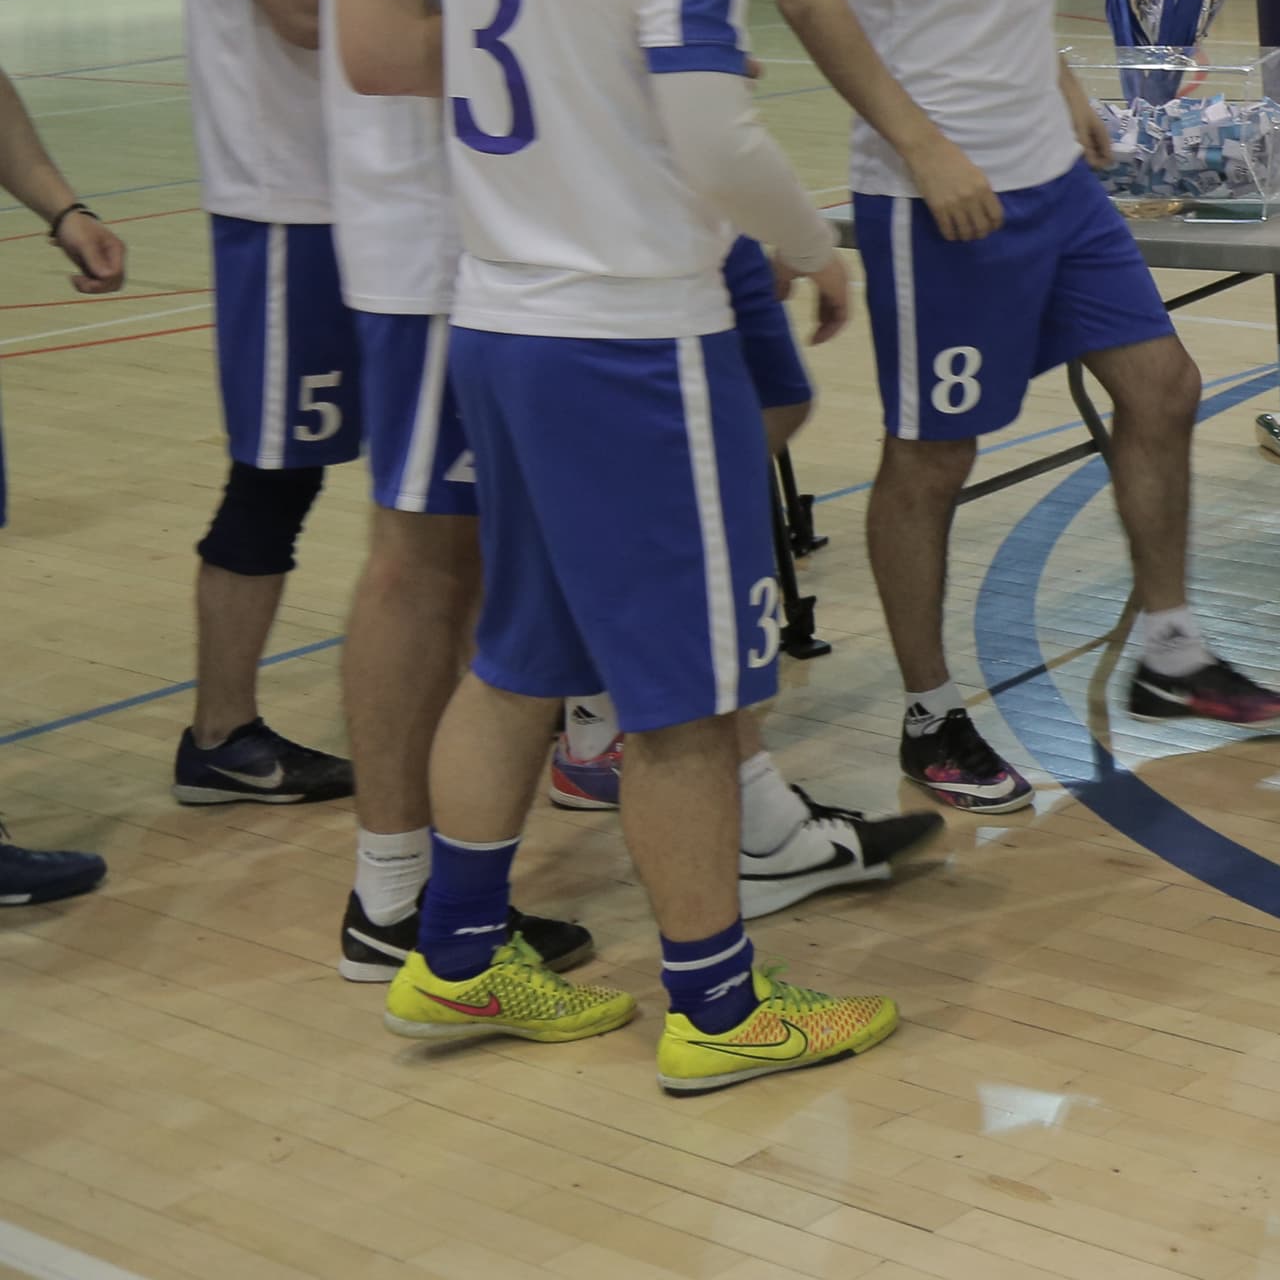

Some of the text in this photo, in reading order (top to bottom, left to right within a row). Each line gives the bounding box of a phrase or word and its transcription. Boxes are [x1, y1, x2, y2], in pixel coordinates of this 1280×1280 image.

[293, 371, 343, 441] 5
[931, 346, 983, 414] 8
[747, 577, 781, 668] 3
